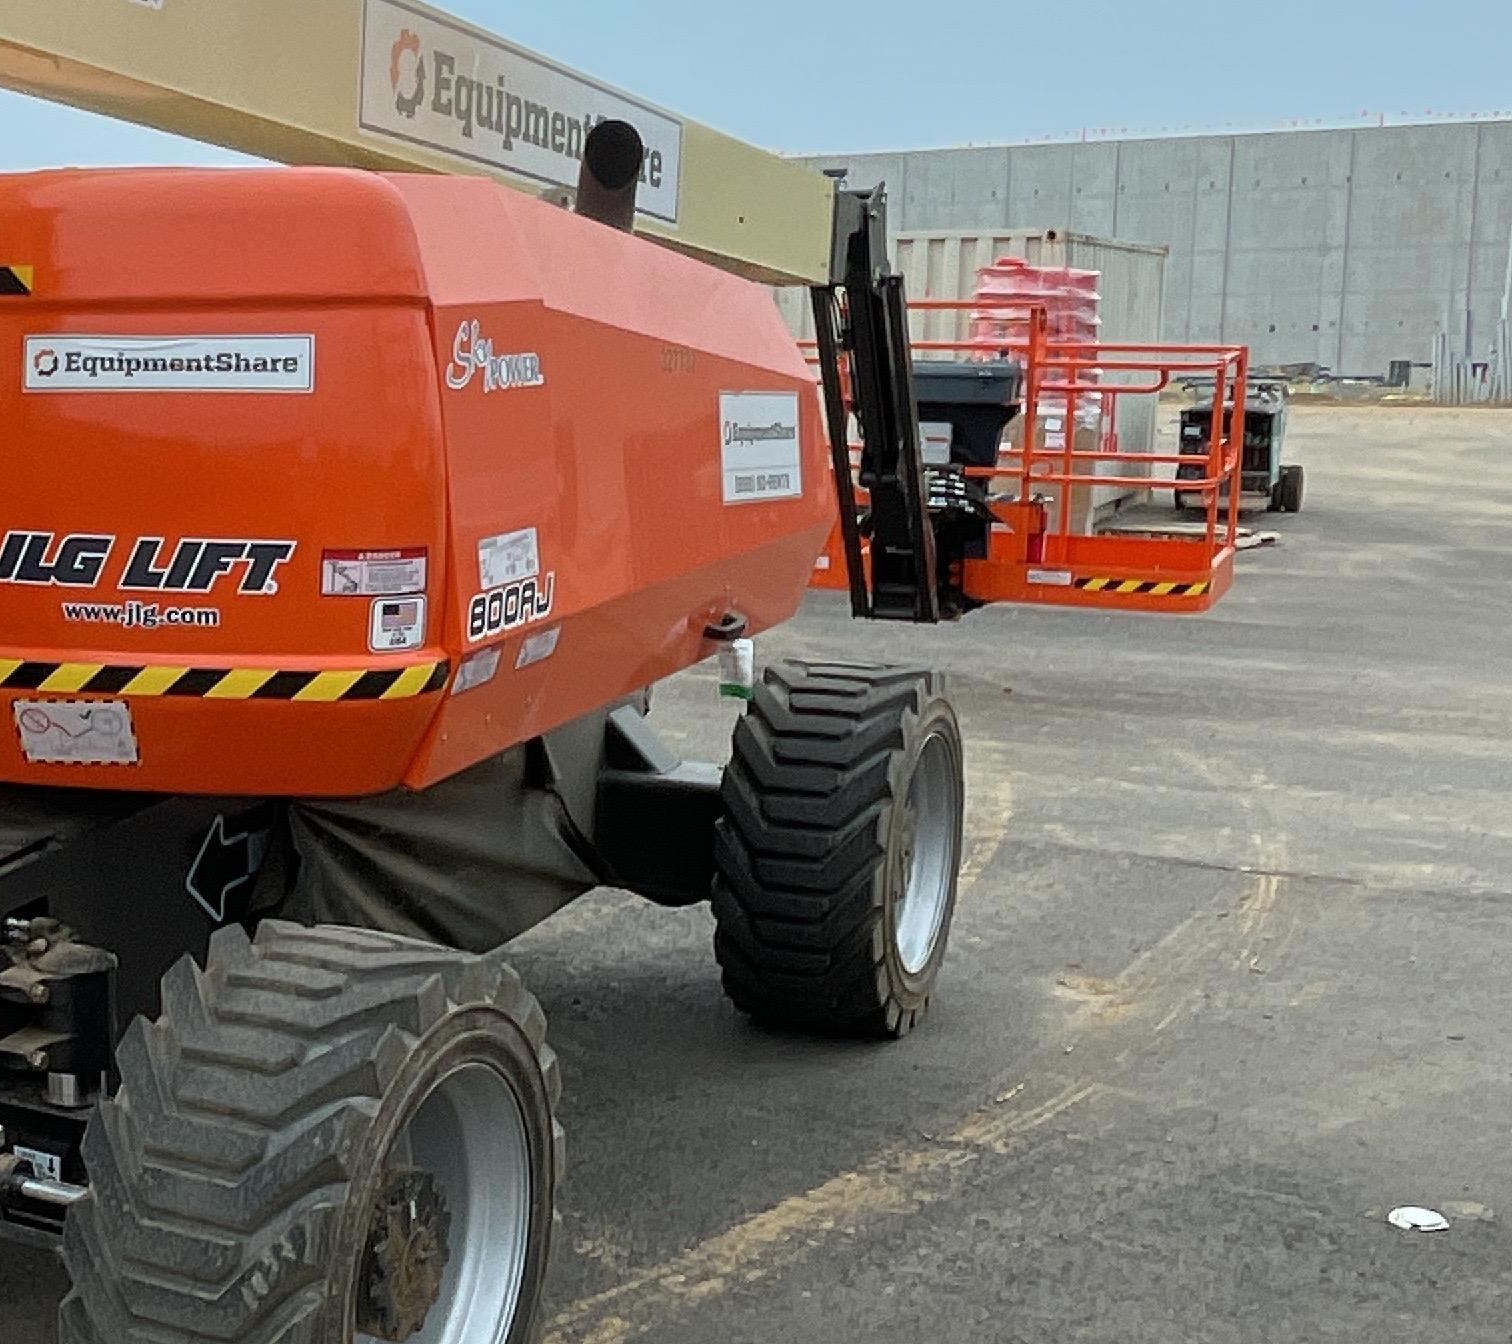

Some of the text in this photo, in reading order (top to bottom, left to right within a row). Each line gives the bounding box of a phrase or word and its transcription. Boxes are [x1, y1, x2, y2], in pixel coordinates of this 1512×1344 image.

[430, 50, 663, 189] Equipmenre
[64, 351, 298, 377] EquipmentShare
[117, 537, 297, 594] LIFT
[61, 601, 219, 627] www.jlg.com
[467, 571, 555, 642] 800AJ
